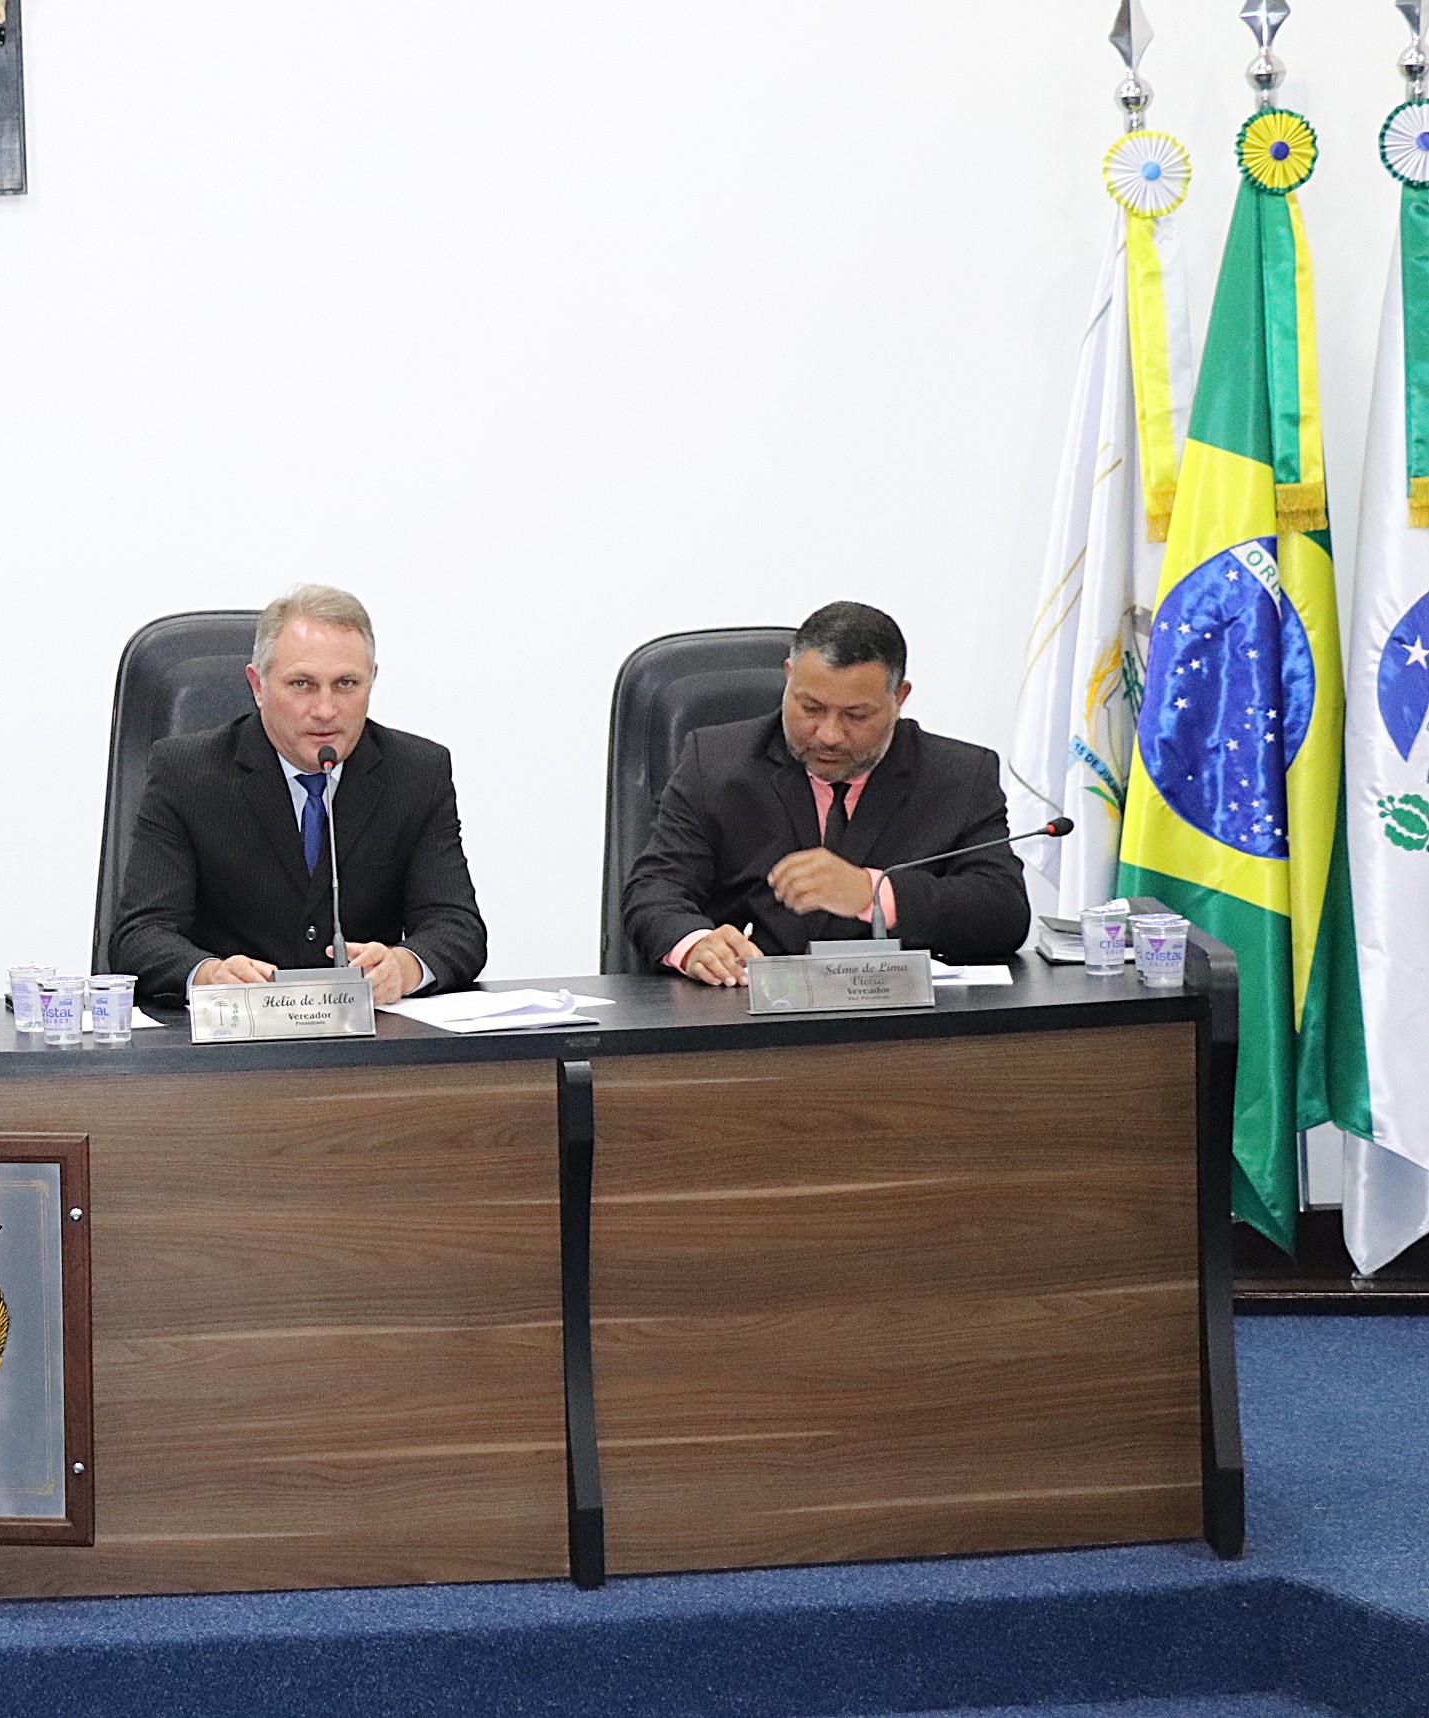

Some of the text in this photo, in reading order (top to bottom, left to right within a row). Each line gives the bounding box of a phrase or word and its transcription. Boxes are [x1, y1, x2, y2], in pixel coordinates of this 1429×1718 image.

[1074, 743, 1086, 755] 15
[1084, 753, 1100, 768] DE
[862, 963, 874, 973] de
[262, 993, 355, 1008] Helio de Mello
[288, 1011, 332, 1020] Vereador
